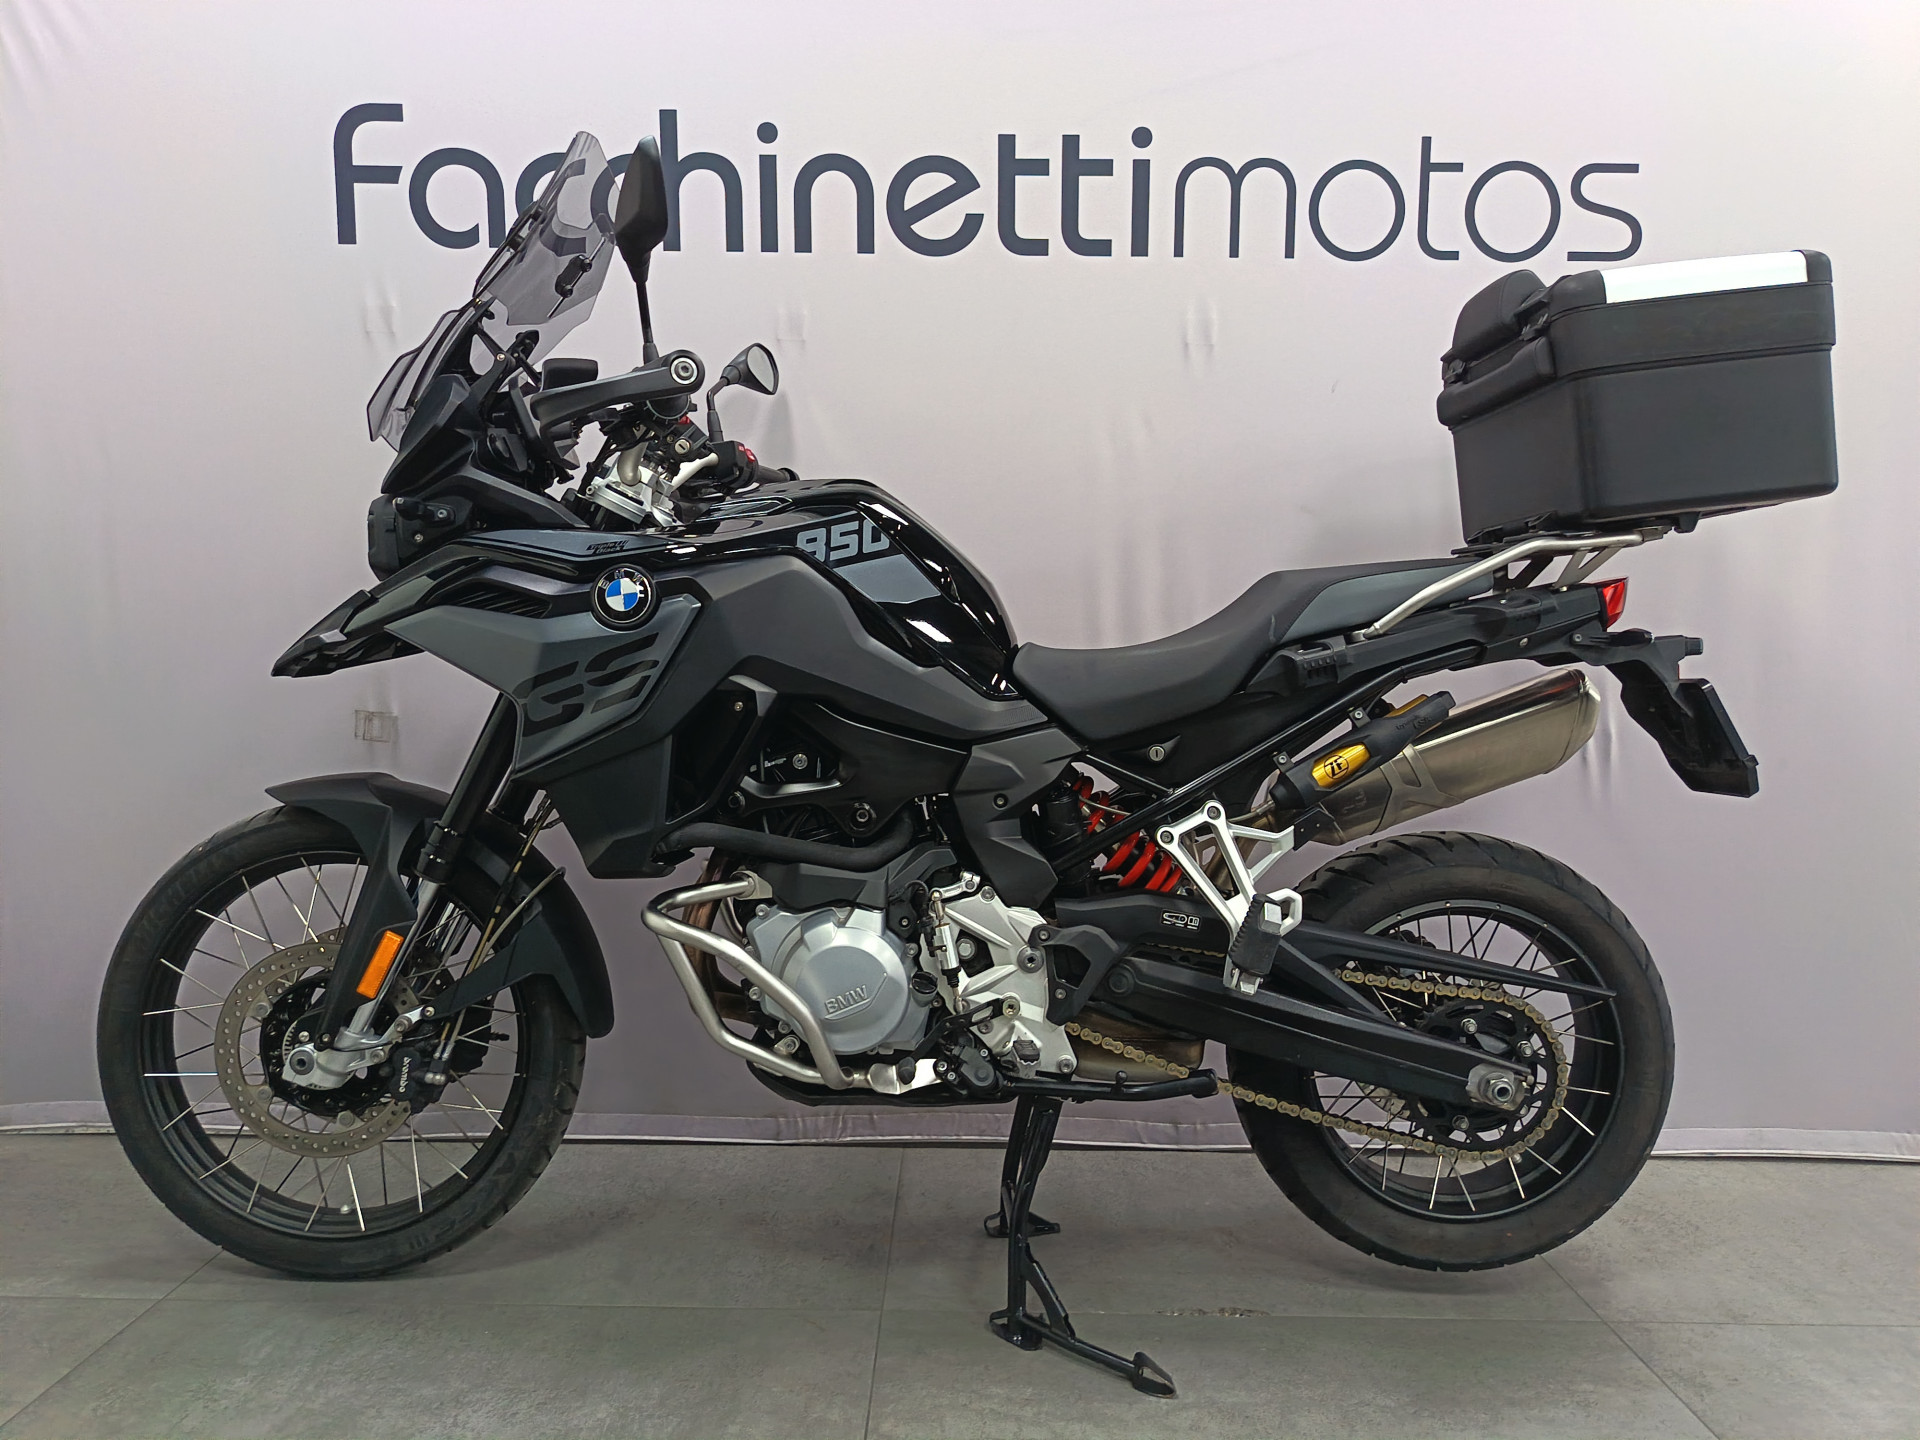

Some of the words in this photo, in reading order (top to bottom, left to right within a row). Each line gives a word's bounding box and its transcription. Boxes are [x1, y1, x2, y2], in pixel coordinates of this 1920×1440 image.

[796, 518, 890, 563] 850
[598, 567, 645, 590] BMW
[511, 631, 660, 738] GS
[824, 984, 868, 1014] BMW
[398, 1056, 413, 1093] brembo
